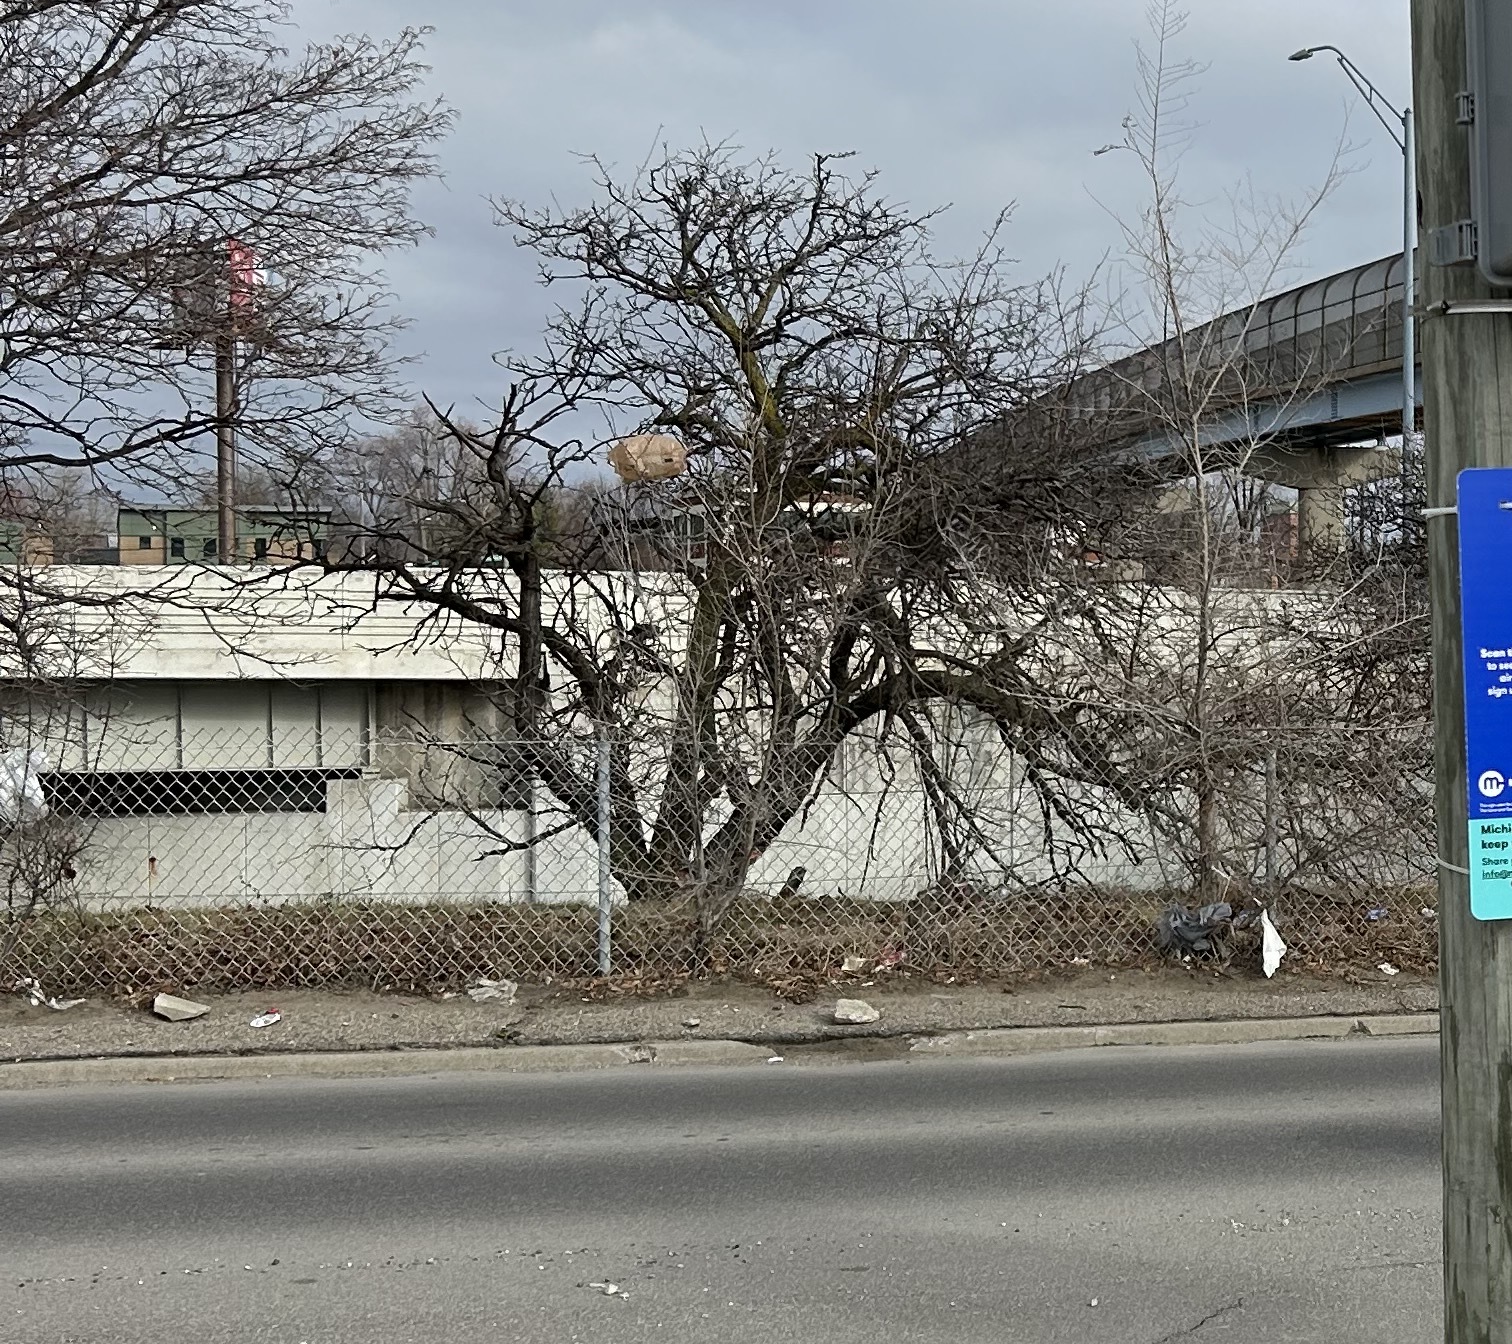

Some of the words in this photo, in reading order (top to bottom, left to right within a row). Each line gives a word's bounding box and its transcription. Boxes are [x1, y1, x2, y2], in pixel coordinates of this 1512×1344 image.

[1480, 648, 1506, 658] Scan
[1486, 661, 1498, 670] to
[1499, 672, 1512, 682] air
[1487, 685, 1508, 698] sign
[1481, 839, 1509, 851] keep
[1482, 858, 1509, 866] Share
